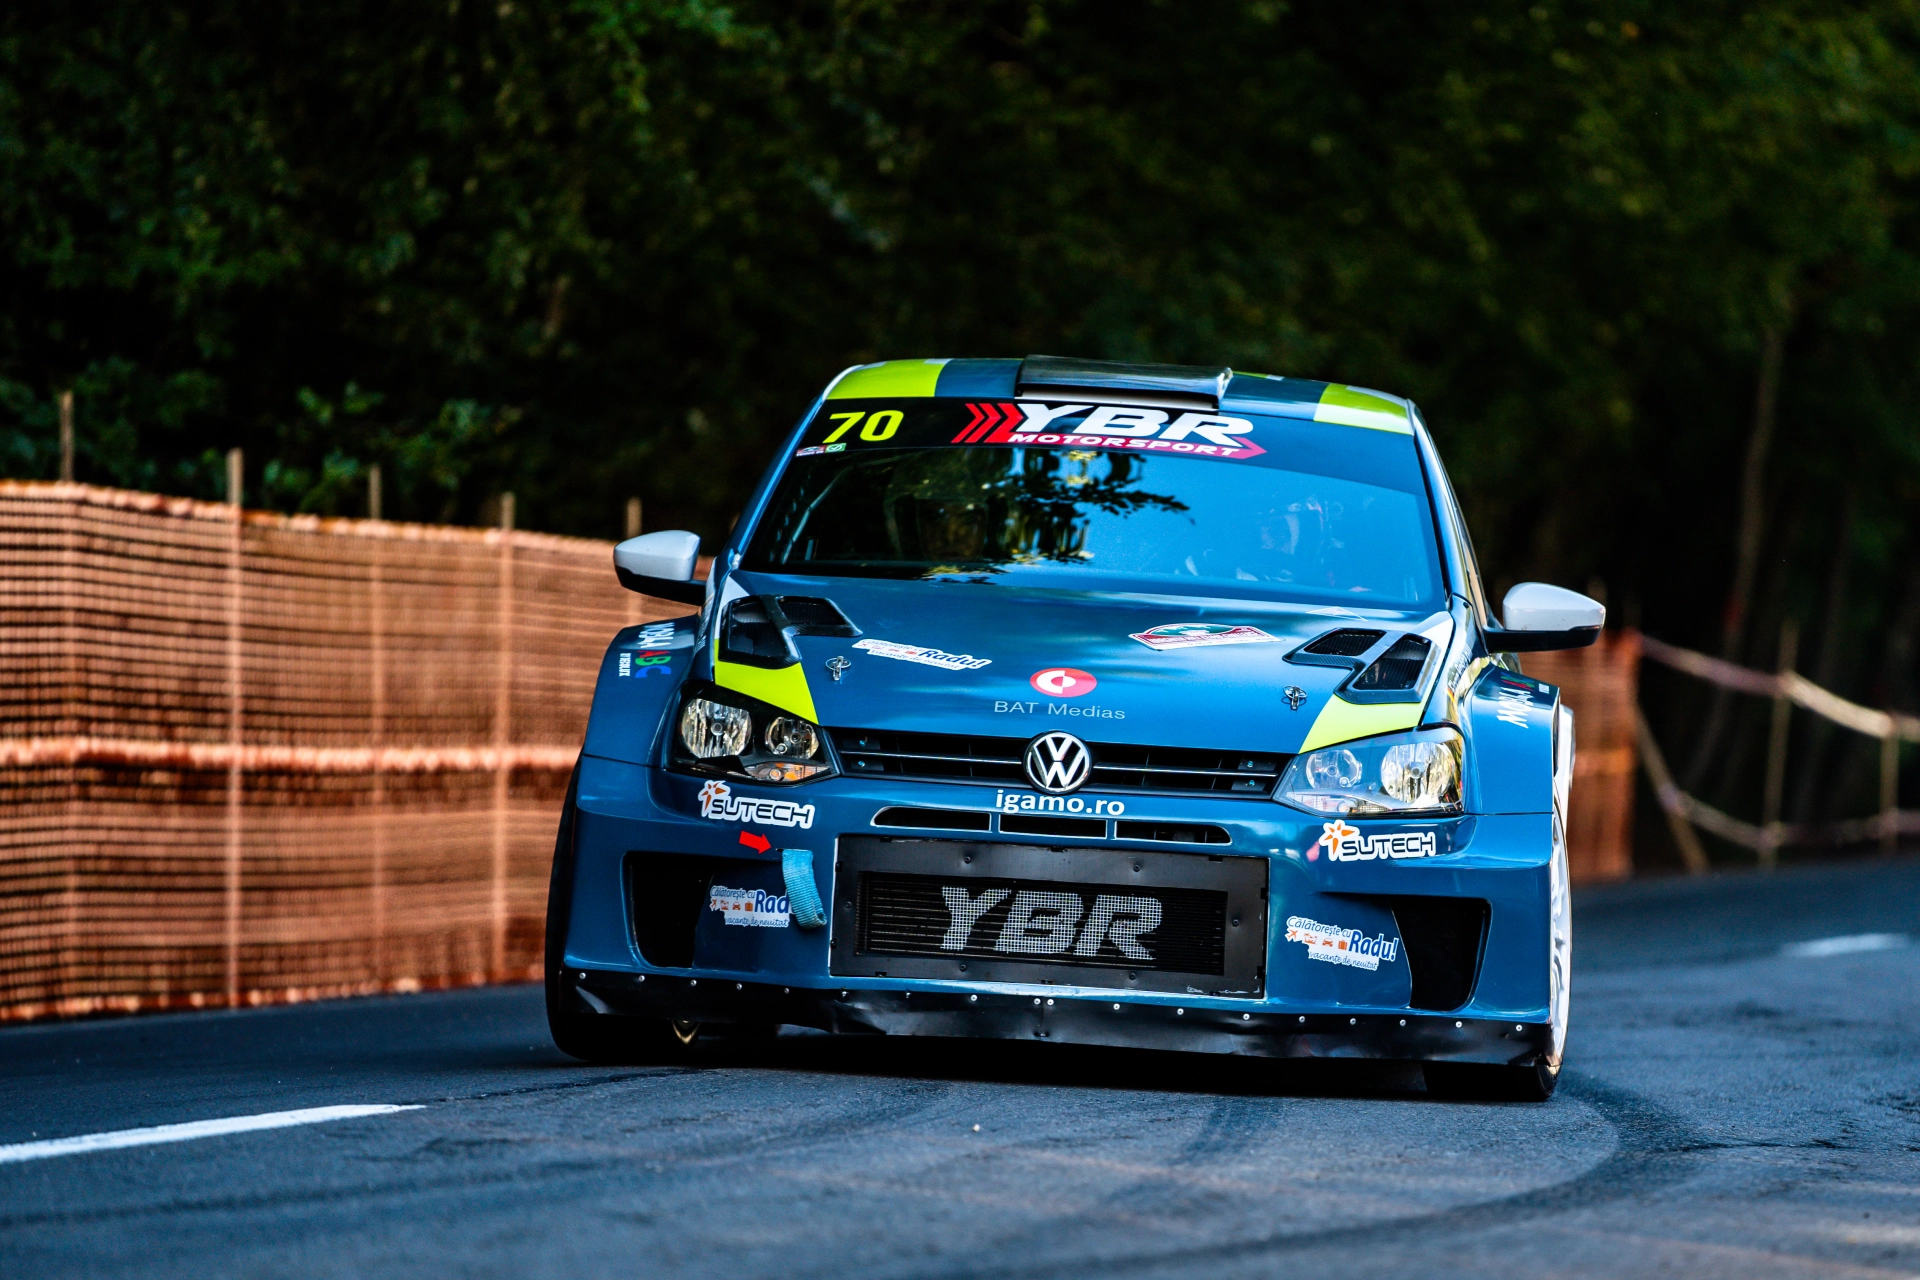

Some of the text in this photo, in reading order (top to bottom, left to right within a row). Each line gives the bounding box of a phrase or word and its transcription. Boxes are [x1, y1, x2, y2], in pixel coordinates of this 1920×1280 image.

[822, 410, 904, 443] 70
[1015, 403, 1254, 448] YBR
[1007, 433, 1242, 456] MOTORSPORT
[634, 650, 672, 679] ABC
[918, 649, 988, 668] Radu!
[994, 700, 1126, 720] BAT Medias
[711, 799, 811, 825] SUTECH
[995, 789, 1126, 816] igamo.ro
[1341, 836, 1433, 857] SUTECH
[747, 891, 756, 899] cu
[754, 890, 790, 914] Rad
[940, 886, 1164, 961] YBR
[1341, 928, 1352, 939] cu
[1348, 930, 1399, 961] Radu!
